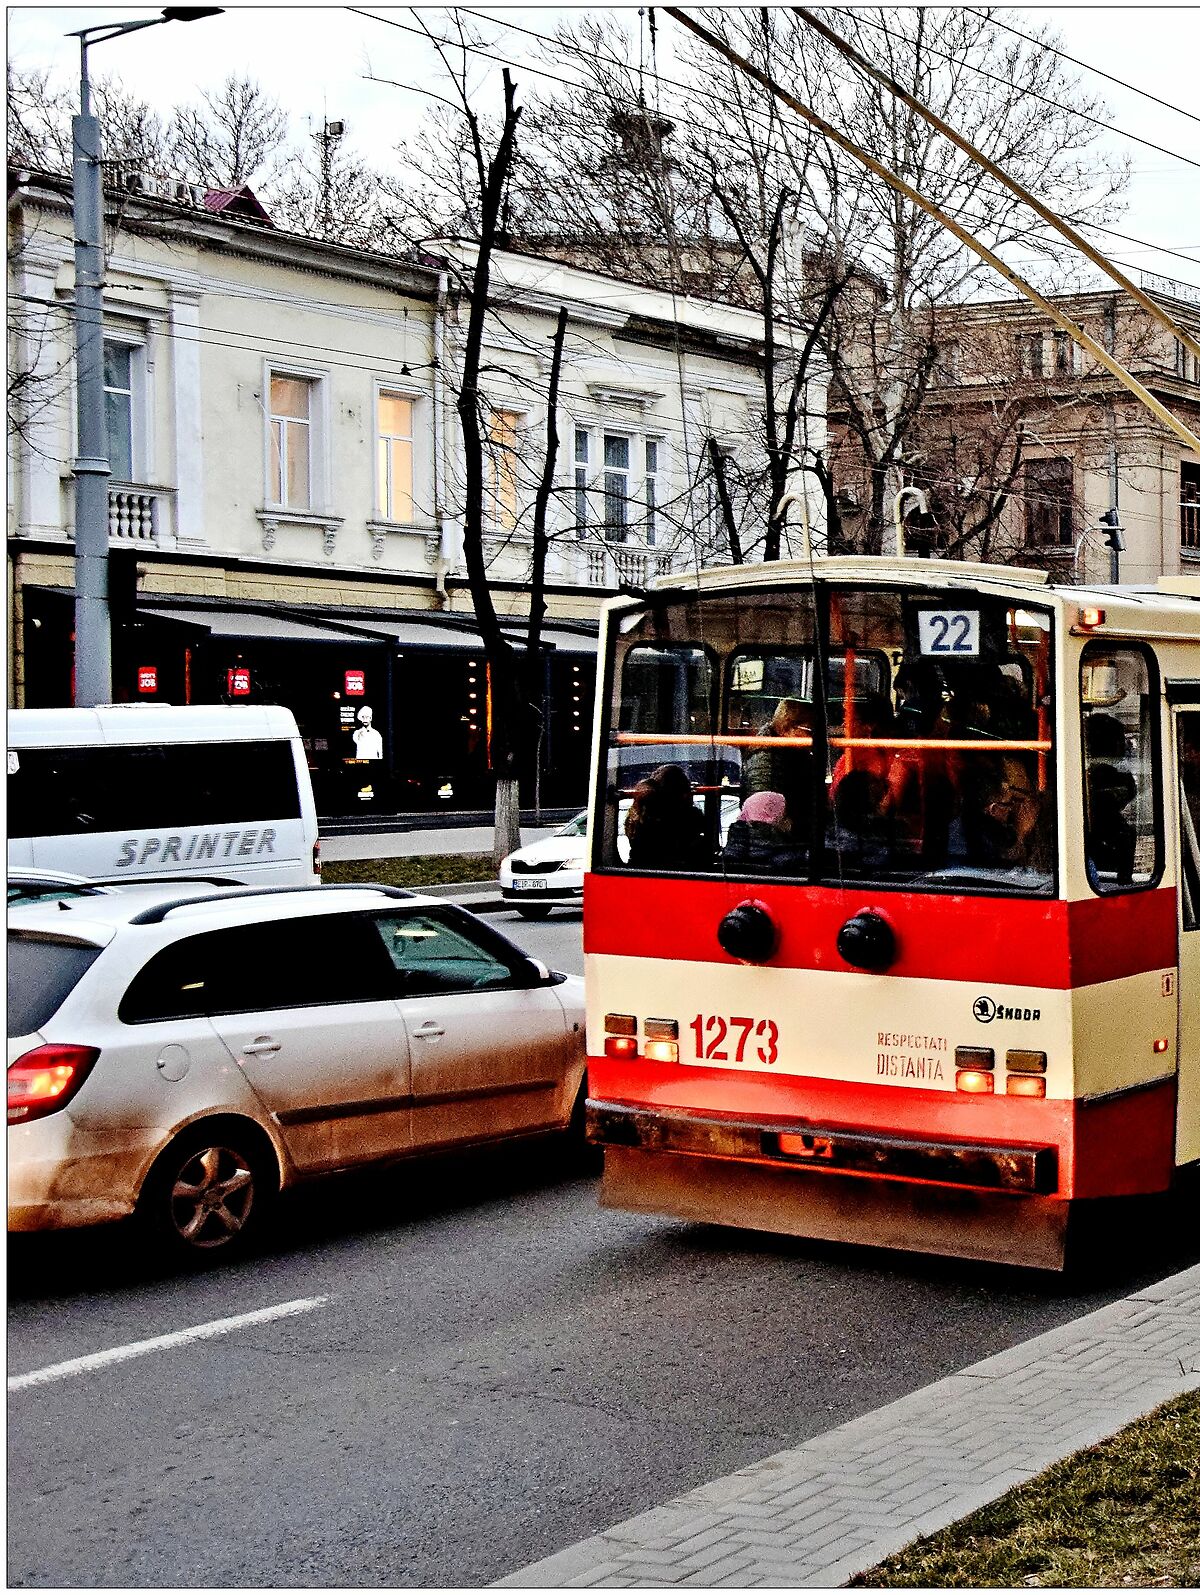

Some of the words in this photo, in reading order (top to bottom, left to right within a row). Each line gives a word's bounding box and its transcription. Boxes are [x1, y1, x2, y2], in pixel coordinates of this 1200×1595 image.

[929, 615, 973, 651] 22
[140, 679, 156, 687] JOB
[114, 828, 277, 867] SPRINTER
[996, 1004, 1041, 1021] ŠKODA
[689, 1013, 779, 1065] 1273
[877, 1032, 947, 1052] RESPECTATI
[876, 1053, 944, 1081] DISTANTA
